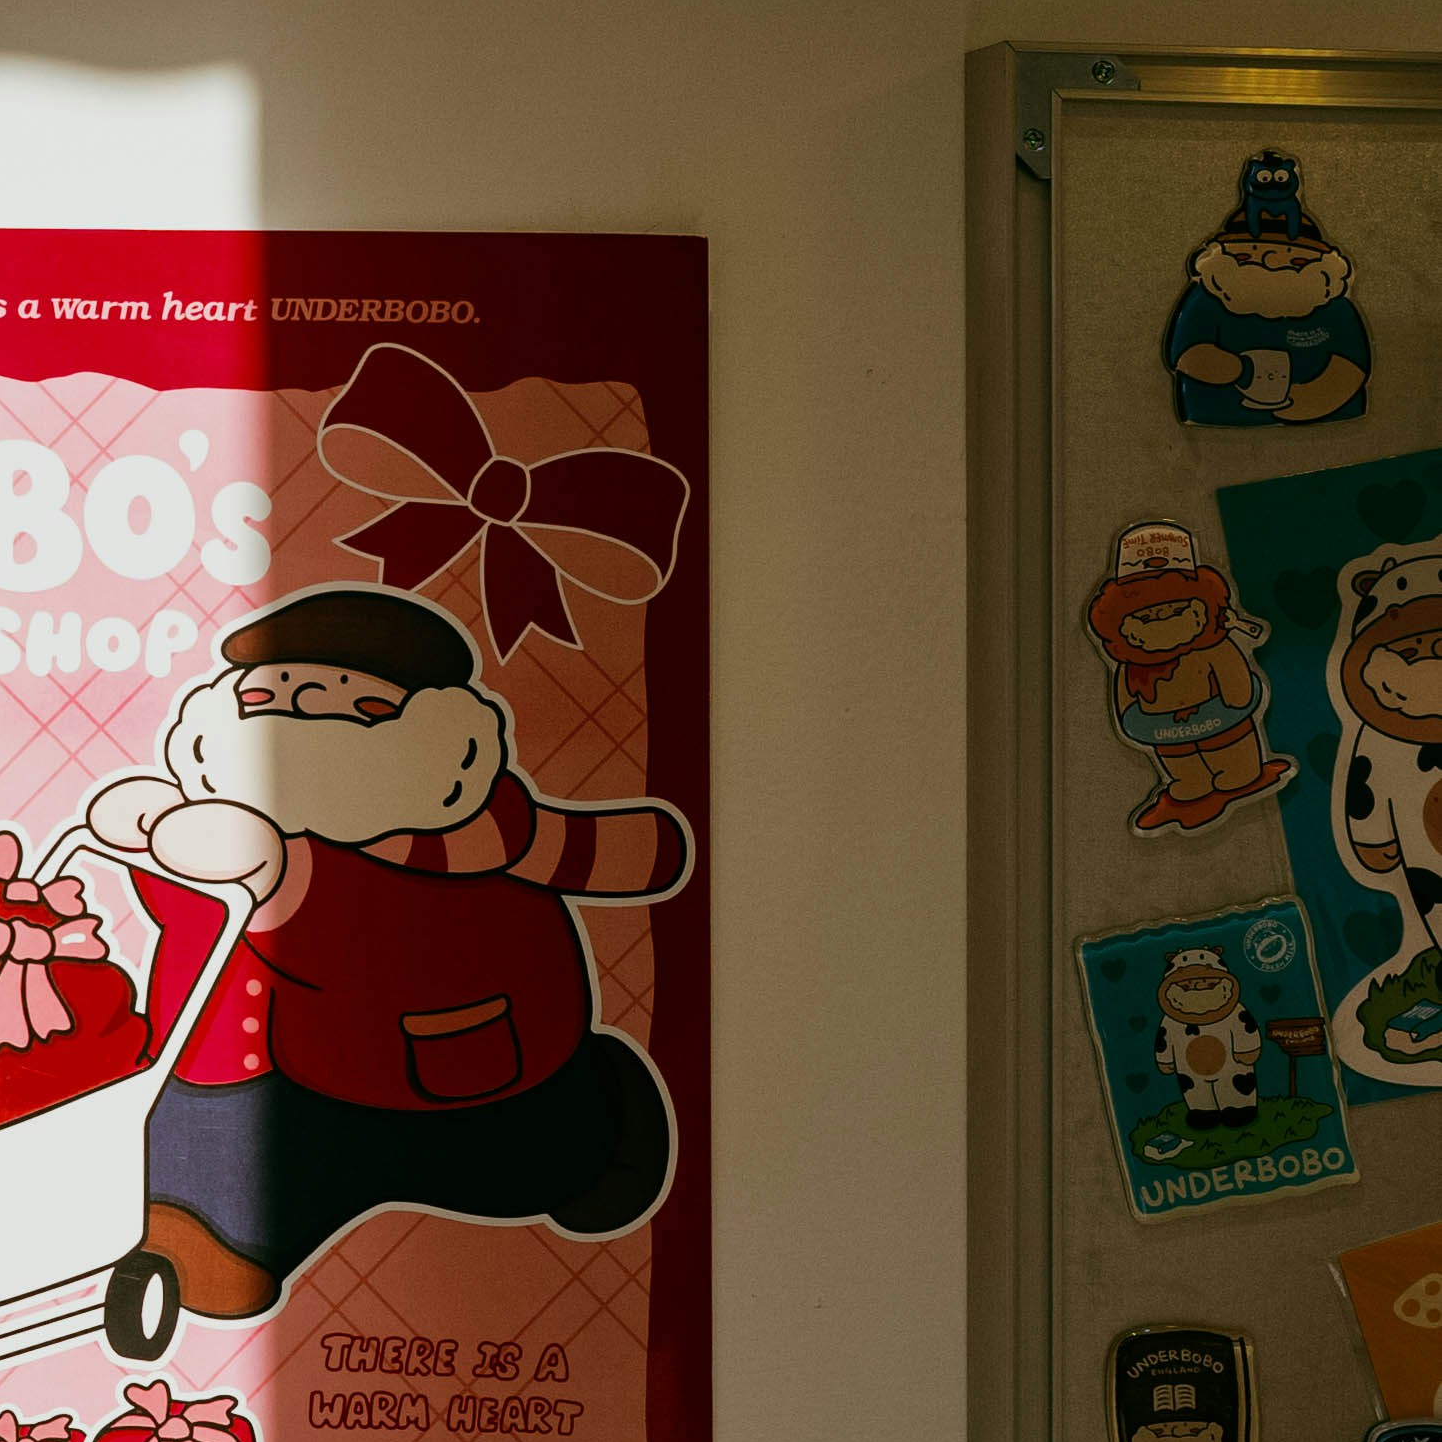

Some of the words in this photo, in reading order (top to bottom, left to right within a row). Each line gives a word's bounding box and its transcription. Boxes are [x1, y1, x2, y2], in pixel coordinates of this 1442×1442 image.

[16, 298, 42, 320] a
[50, 297, 152, 321] warm
[160, 291, 259, 322] heart
[269, 297, 481, 325] UNDERBOBO.
[1153, 718, 1222, 739] UNDERBOBO
[1139, 1145, 1347, 1207] UNDERBOBO
[321, 1332, 459, 1377] THERE
[472, 1340, 523, 1381] IS
[533, 1342, 570, 1382] A
[1125, 1348, 1225, 1379] UNDERBOBO
[308, 1390, 430, 1432] WARM
[446, 1394, 585, 1436] HEART
